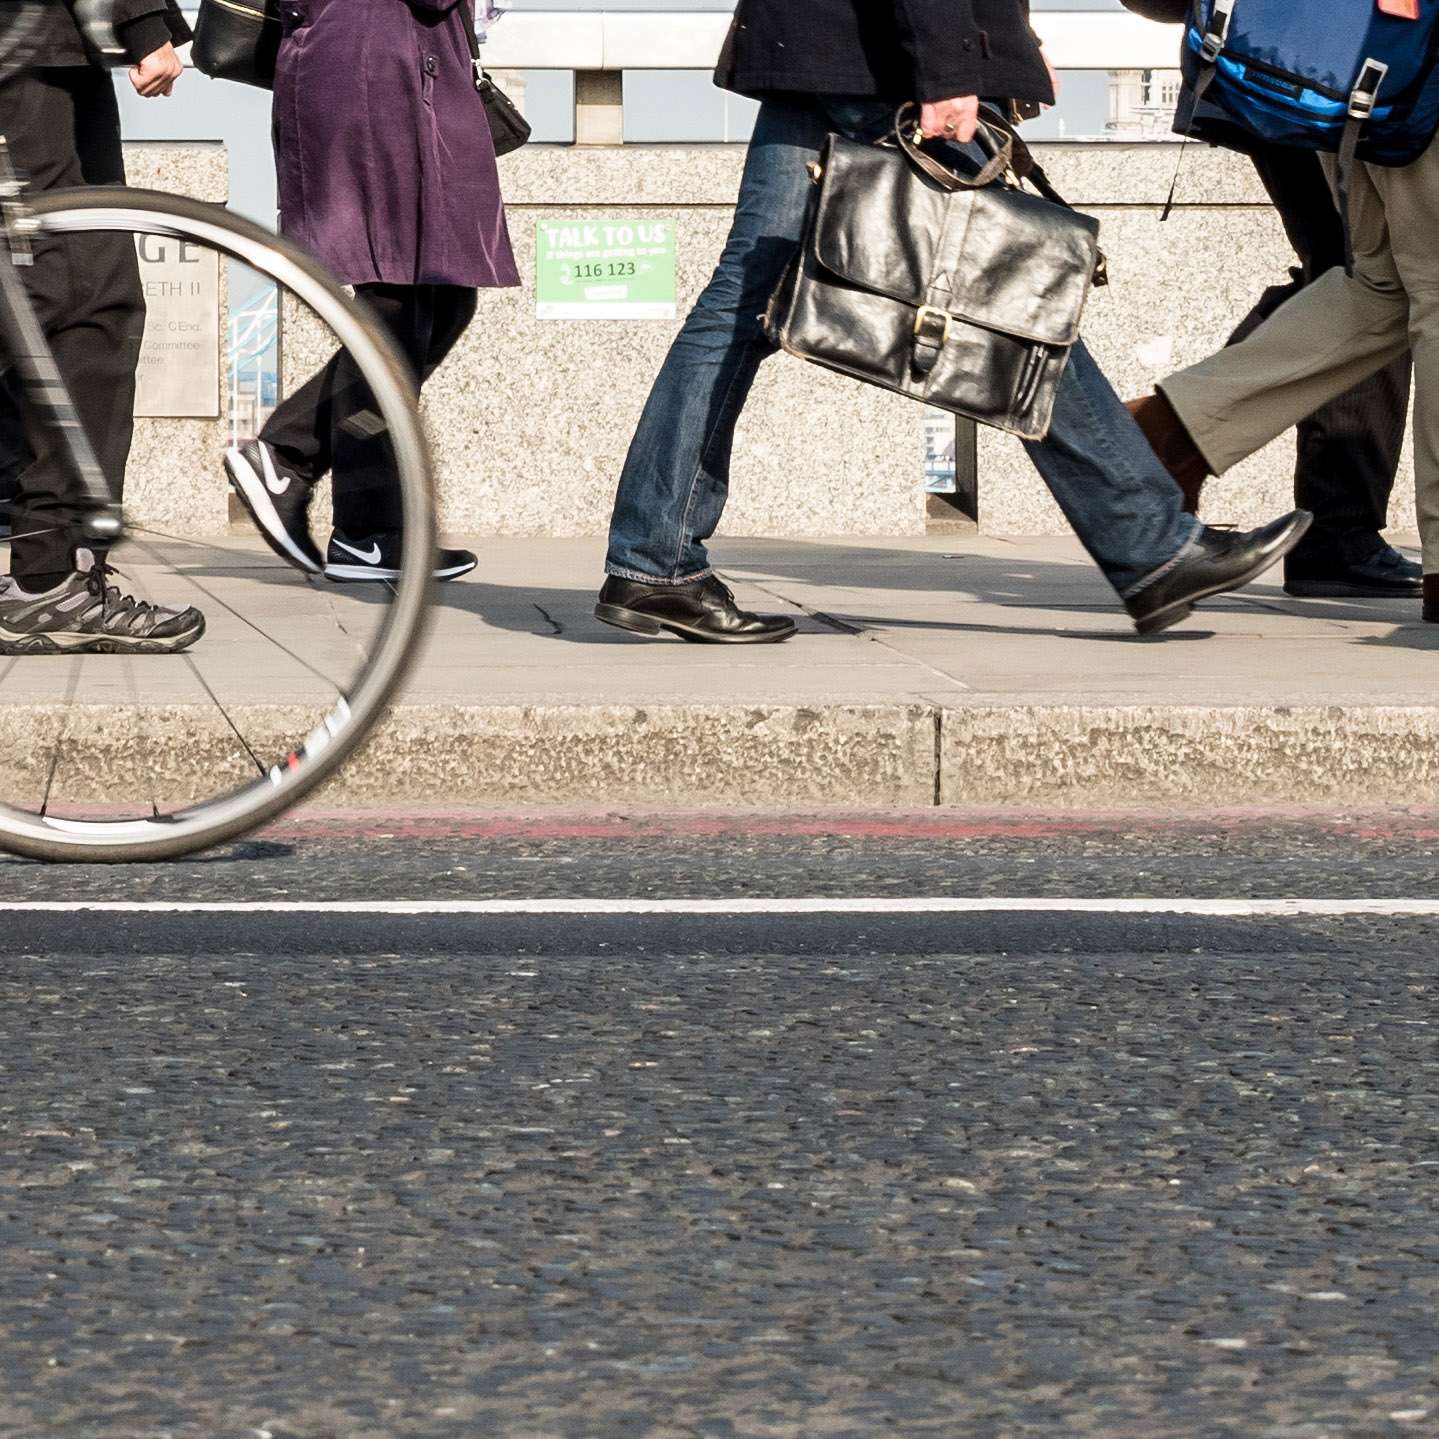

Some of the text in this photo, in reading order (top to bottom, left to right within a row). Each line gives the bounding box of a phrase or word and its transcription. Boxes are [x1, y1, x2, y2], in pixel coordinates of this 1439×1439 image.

[546, 223, 666, 248] TALK TO US
[138, 233, 200, 263] GE
[575, 263, 603, 278] 116
[608, 261, 636, 276] 123
[145, 281, 182, 296] ETH
[144, 339, 200, 351] Committee
